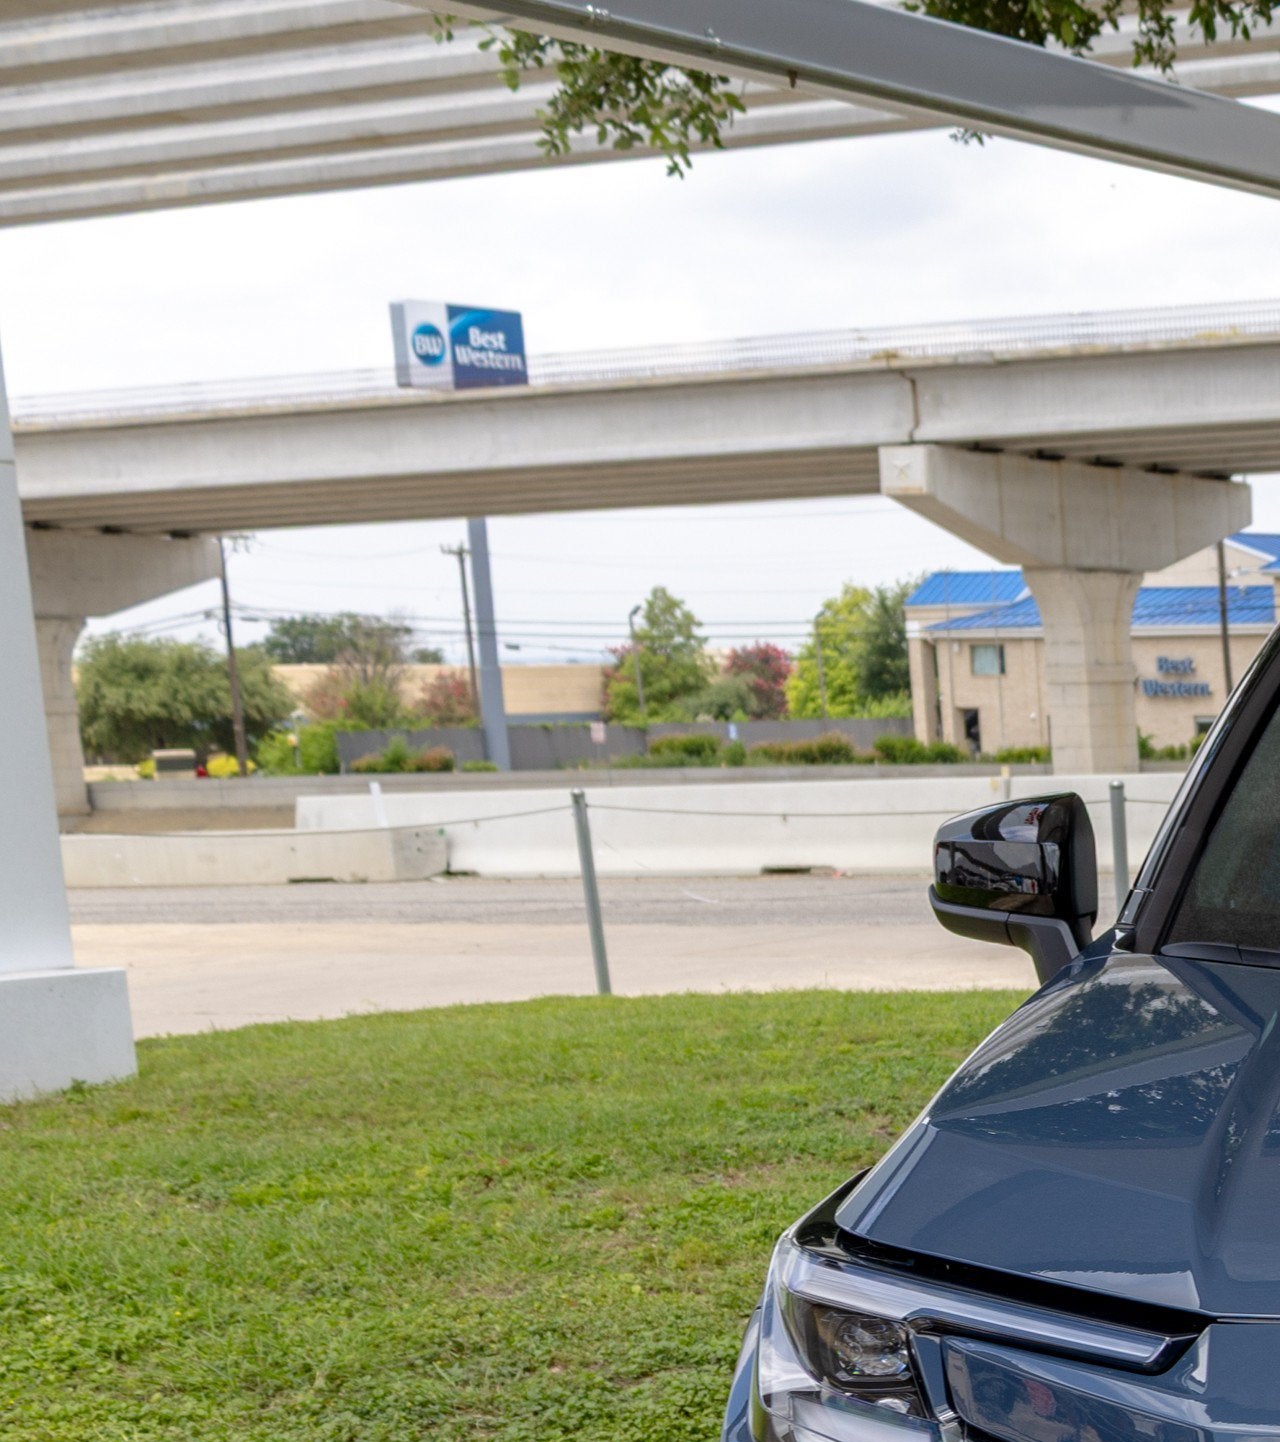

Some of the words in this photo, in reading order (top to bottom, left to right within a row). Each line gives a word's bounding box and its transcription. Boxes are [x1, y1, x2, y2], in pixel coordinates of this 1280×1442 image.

[468, 326, 505, 351] Best
[455, 345, 524, 370] Western
[1157, 656, 1194, 674] Best
[1142, 679, 1211, 697] Western
